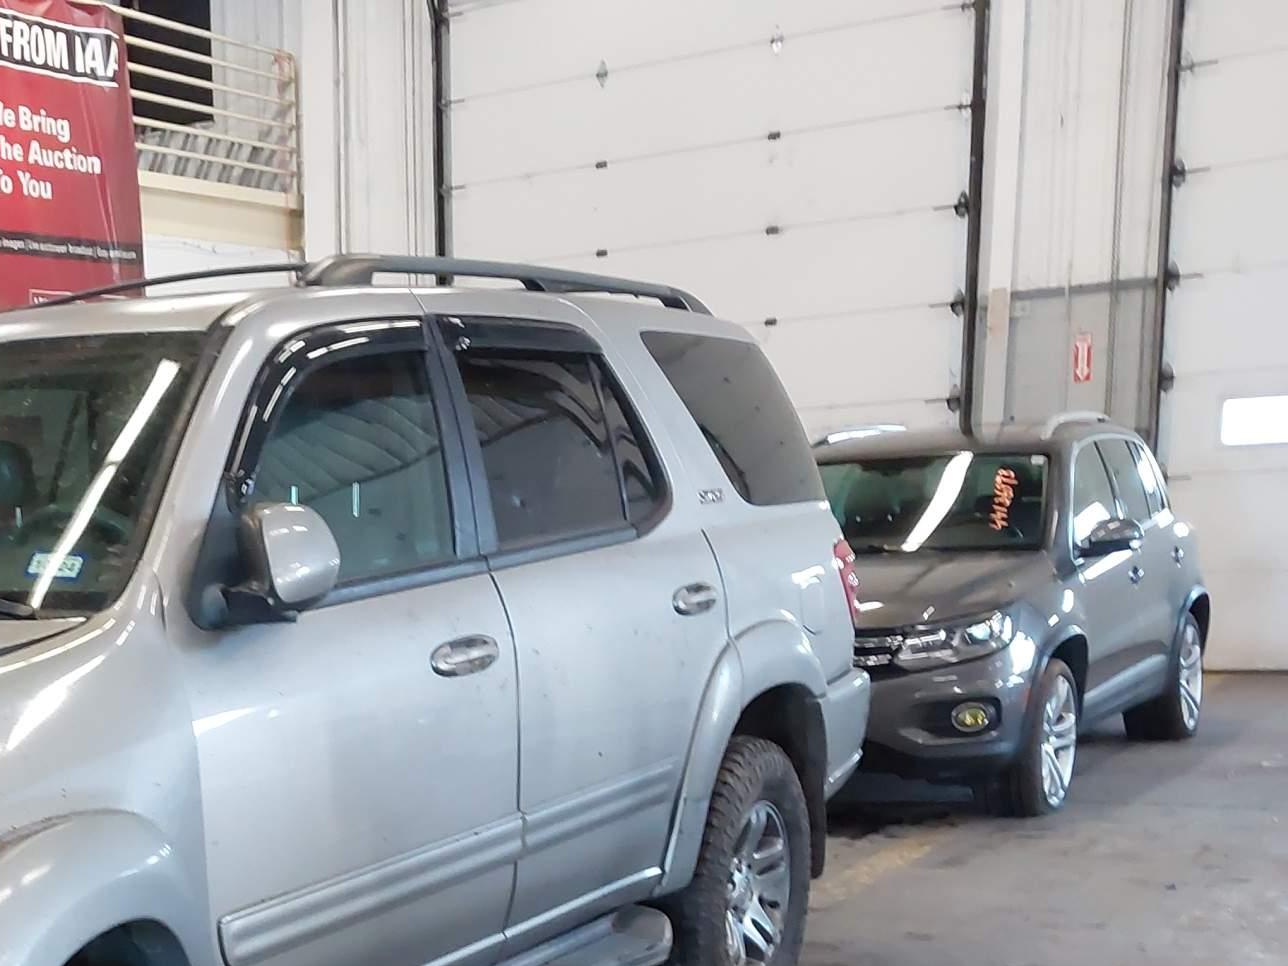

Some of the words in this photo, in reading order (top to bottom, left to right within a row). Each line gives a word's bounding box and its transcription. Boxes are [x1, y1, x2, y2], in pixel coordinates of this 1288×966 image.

[18, 105, 70, 143] Bring
[28, 140, 101, 174] Auction
[17, 170, 53, 199] You
